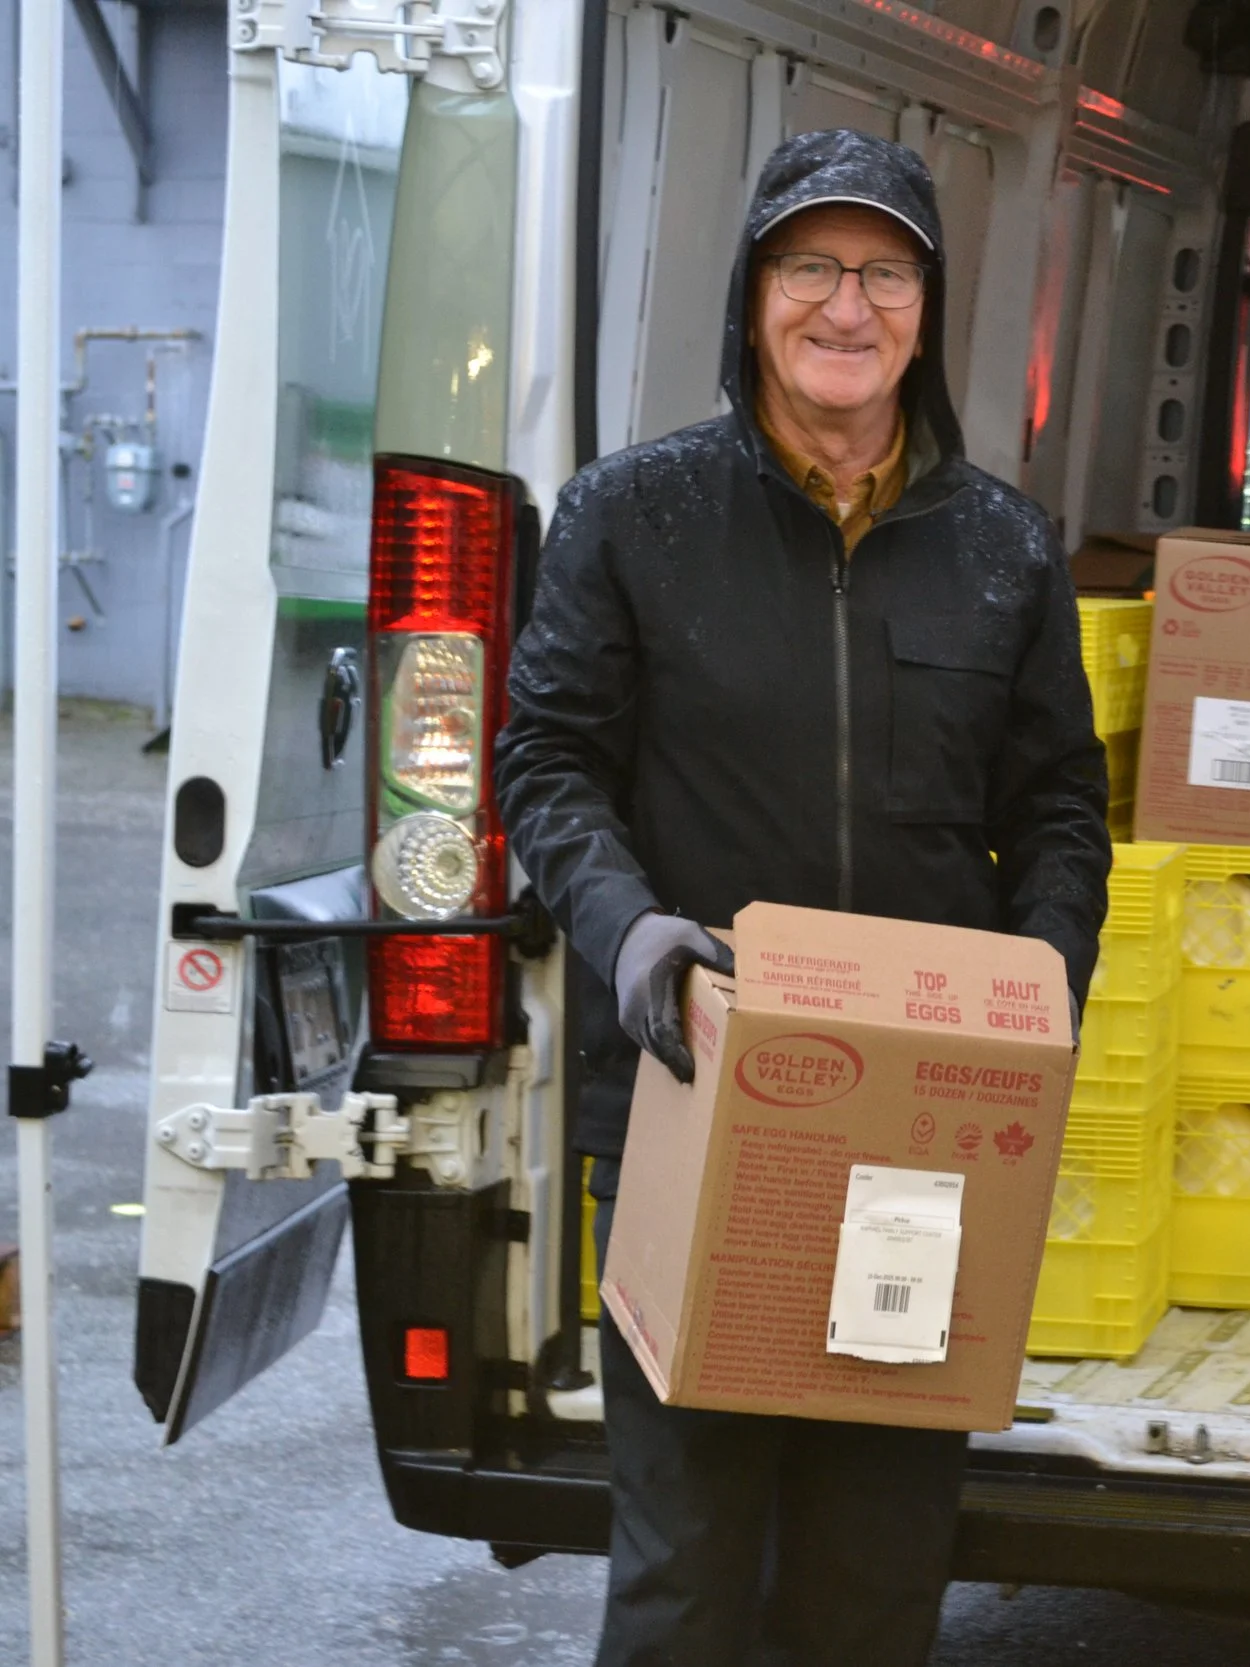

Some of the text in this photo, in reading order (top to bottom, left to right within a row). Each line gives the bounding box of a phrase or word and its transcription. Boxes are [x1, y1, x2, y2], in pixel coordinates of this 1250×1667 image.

[1184, 569, 1250, 585] GOLDEN
[1187, 582, 1250, 596] VALLEY
[760, 951, 785, 963] KEEP
[787, 954, 861, 972] REFRIGERATED
[914, 968, 947, 992] TOP
[991, 978, 1041, 1002] HAUT
[783, 992, 844, 1011] FRAGILE
[905, 1001, 962, 1025] EGGS
[986, 1010, 1051, 1035] ŒUFS
[756, 1051, 846, 1074] GOLDEN
[915, 1060, 1044, 1093] EGGS/ŒUFS
[776, 1084, 815, 1097] EGGS
[929, 1086, 966, 1100] DOZEN
[731, 1122, 848, 1146] SAFE EGG HANDLING
